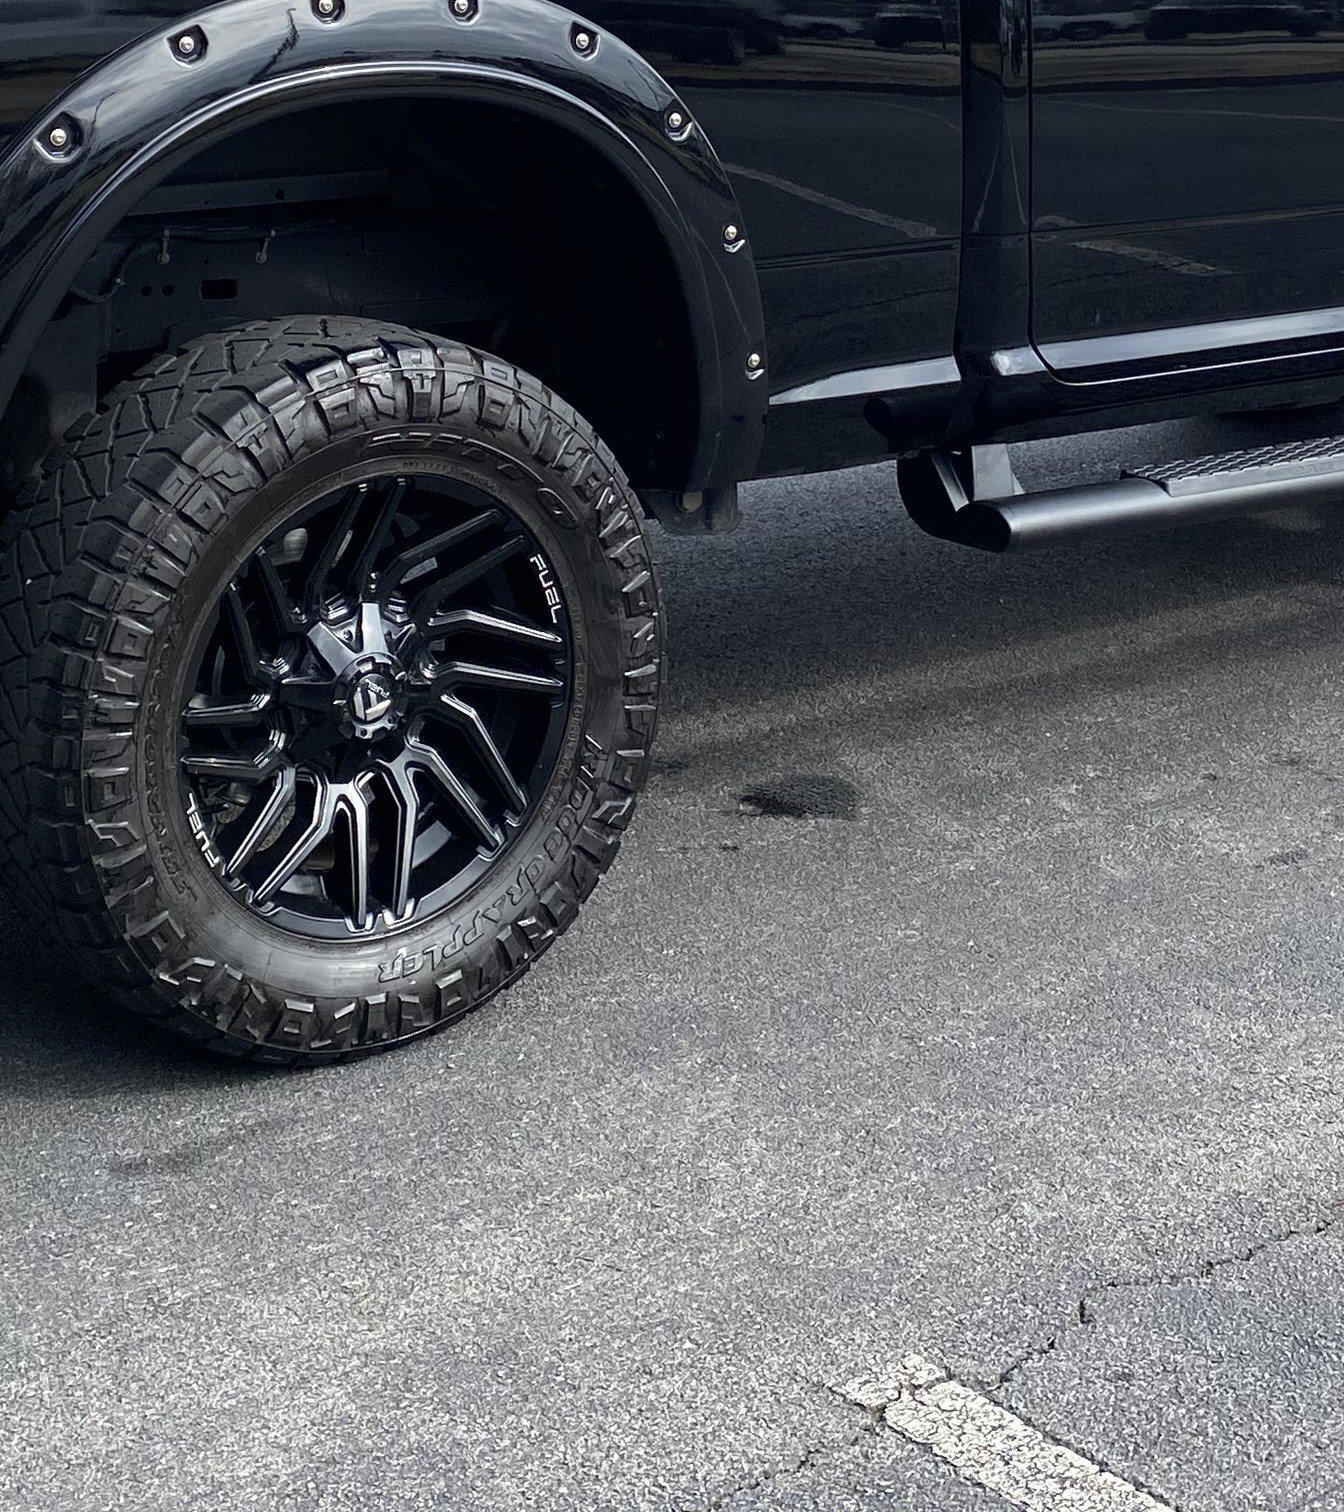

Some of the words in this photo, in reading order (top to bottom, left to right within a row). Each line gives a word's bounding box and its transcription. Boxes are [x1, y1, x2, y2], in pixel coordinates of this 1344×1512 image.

[530, 553, 562, 624] FUEL
[187, 792, 221, 868] FUEL
[377, 853, 545, 983] GRAPPLER
